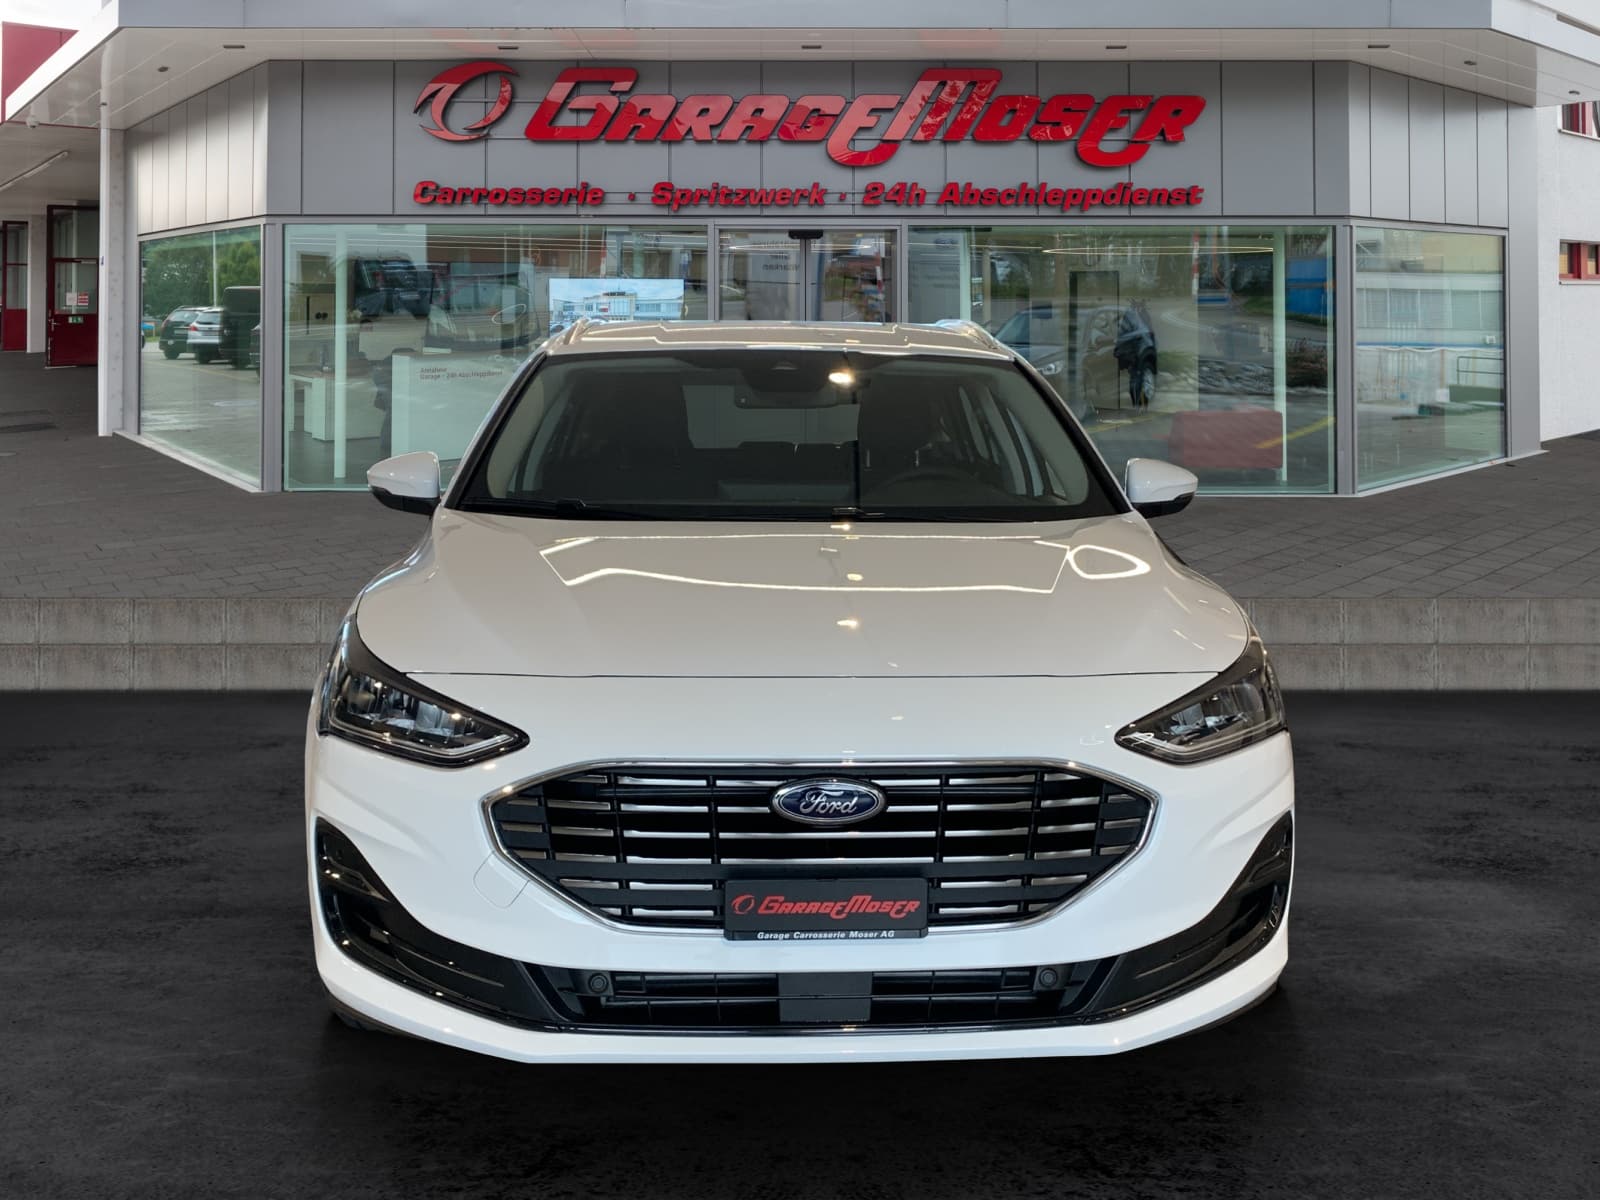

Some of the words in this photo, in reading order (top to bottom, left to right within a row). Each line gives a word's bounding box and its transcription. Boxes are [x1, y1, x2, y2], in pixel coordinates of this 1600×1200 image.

[412, 180, 605, 206] Carrosserie
[650, 181, 827, 212] Spritzwerk
[862, 181, 927, 206] 24h
[936, 181, 1205, 212] Abschleppdienst
[800, 790, 859, 814] Ford
[757, 931, 790, 940] Garage
[793, 931, 846, 939] Carrosserie
[849, 930, 878, 938] Moser
[880, 930, 895, 938] AG
